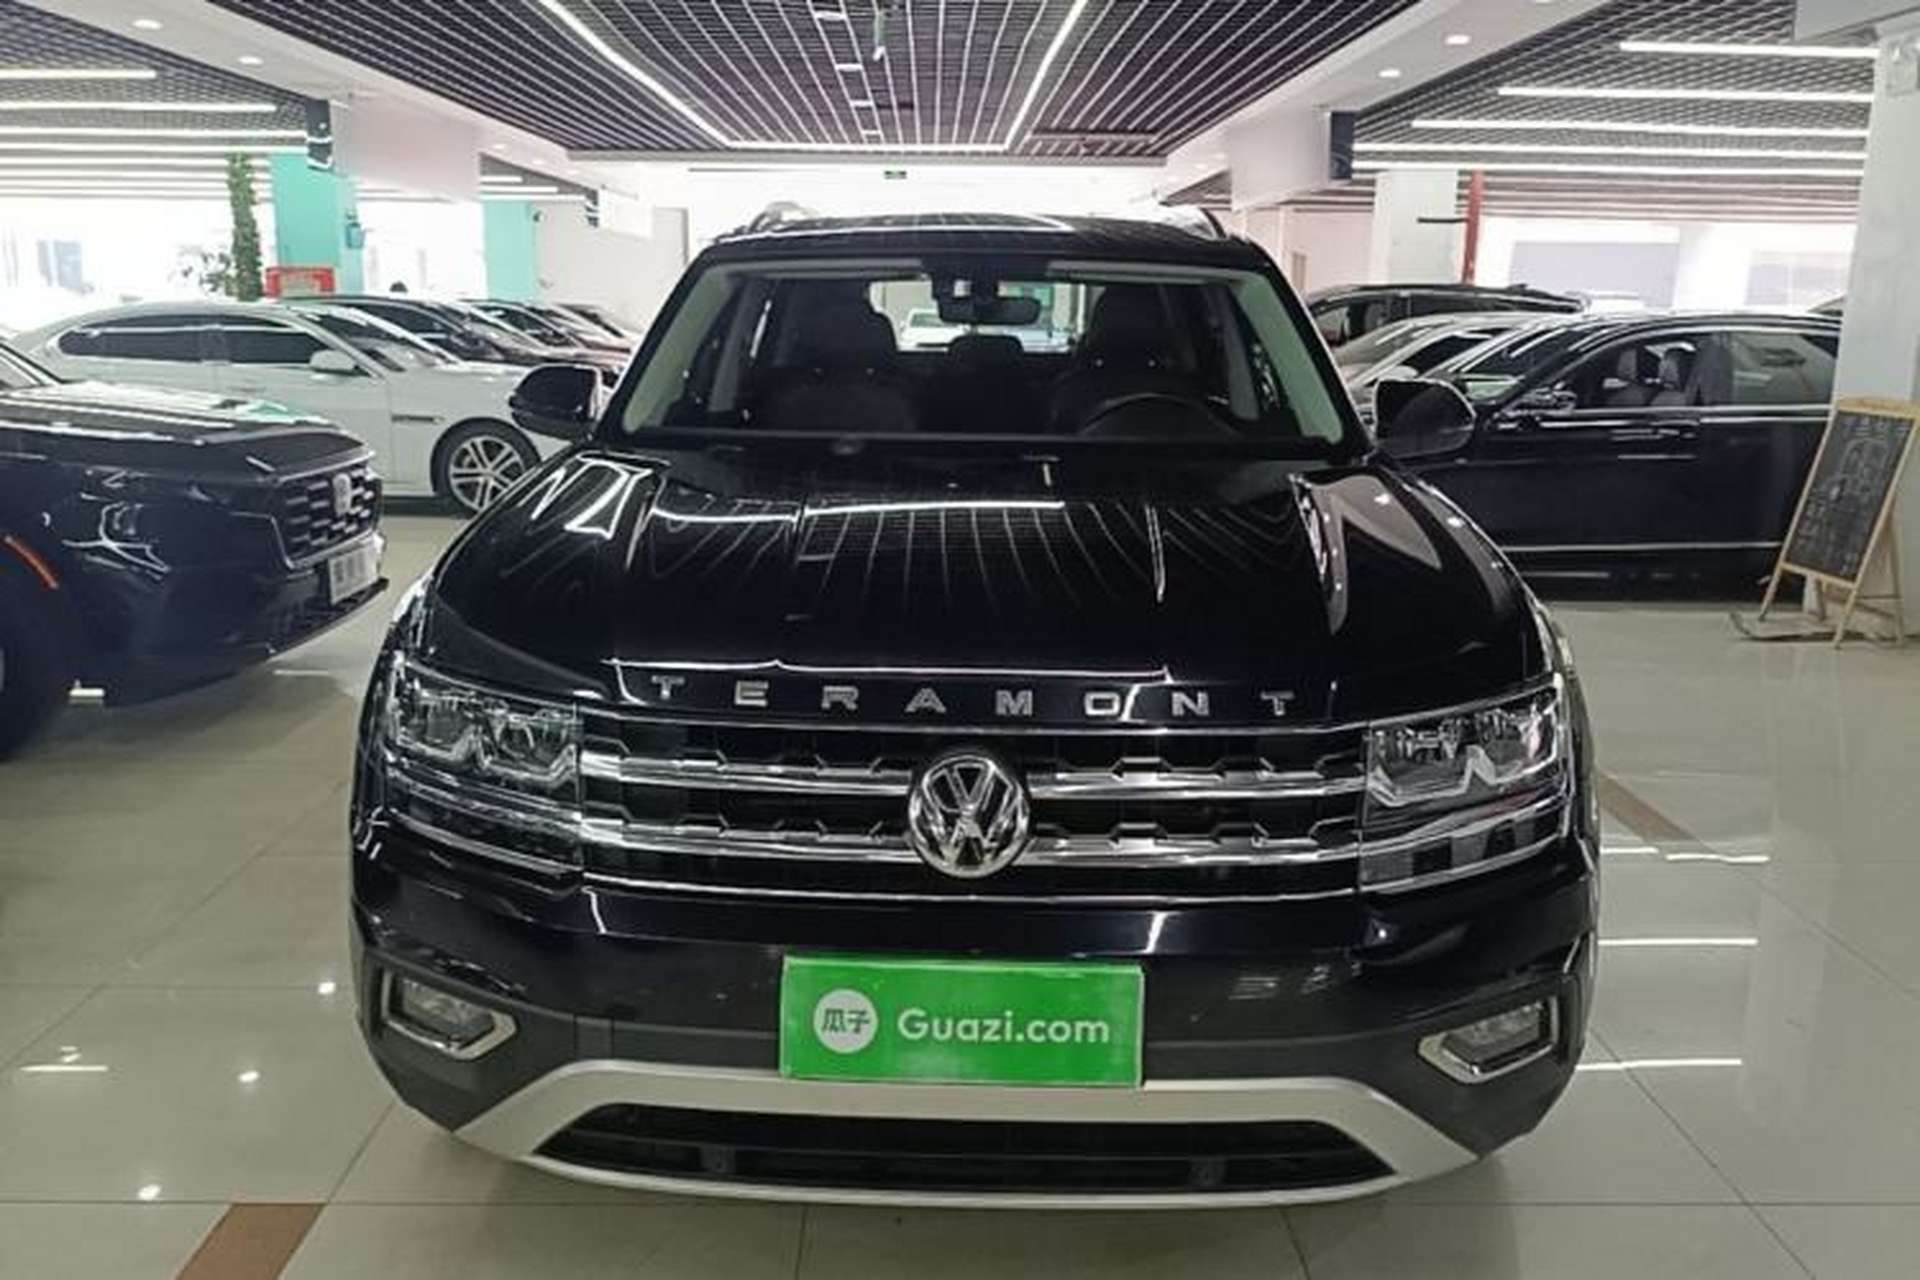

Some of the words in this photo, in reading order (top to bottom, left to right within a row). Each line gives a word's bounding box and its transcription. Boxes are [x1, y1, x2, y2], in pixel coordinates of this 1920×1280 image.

[651, 675, 1294, 717] TERAMONT
[820, 1008, 871, 1036] 瓜子
[897, 1008, 1110, 1044] Guazi.com
